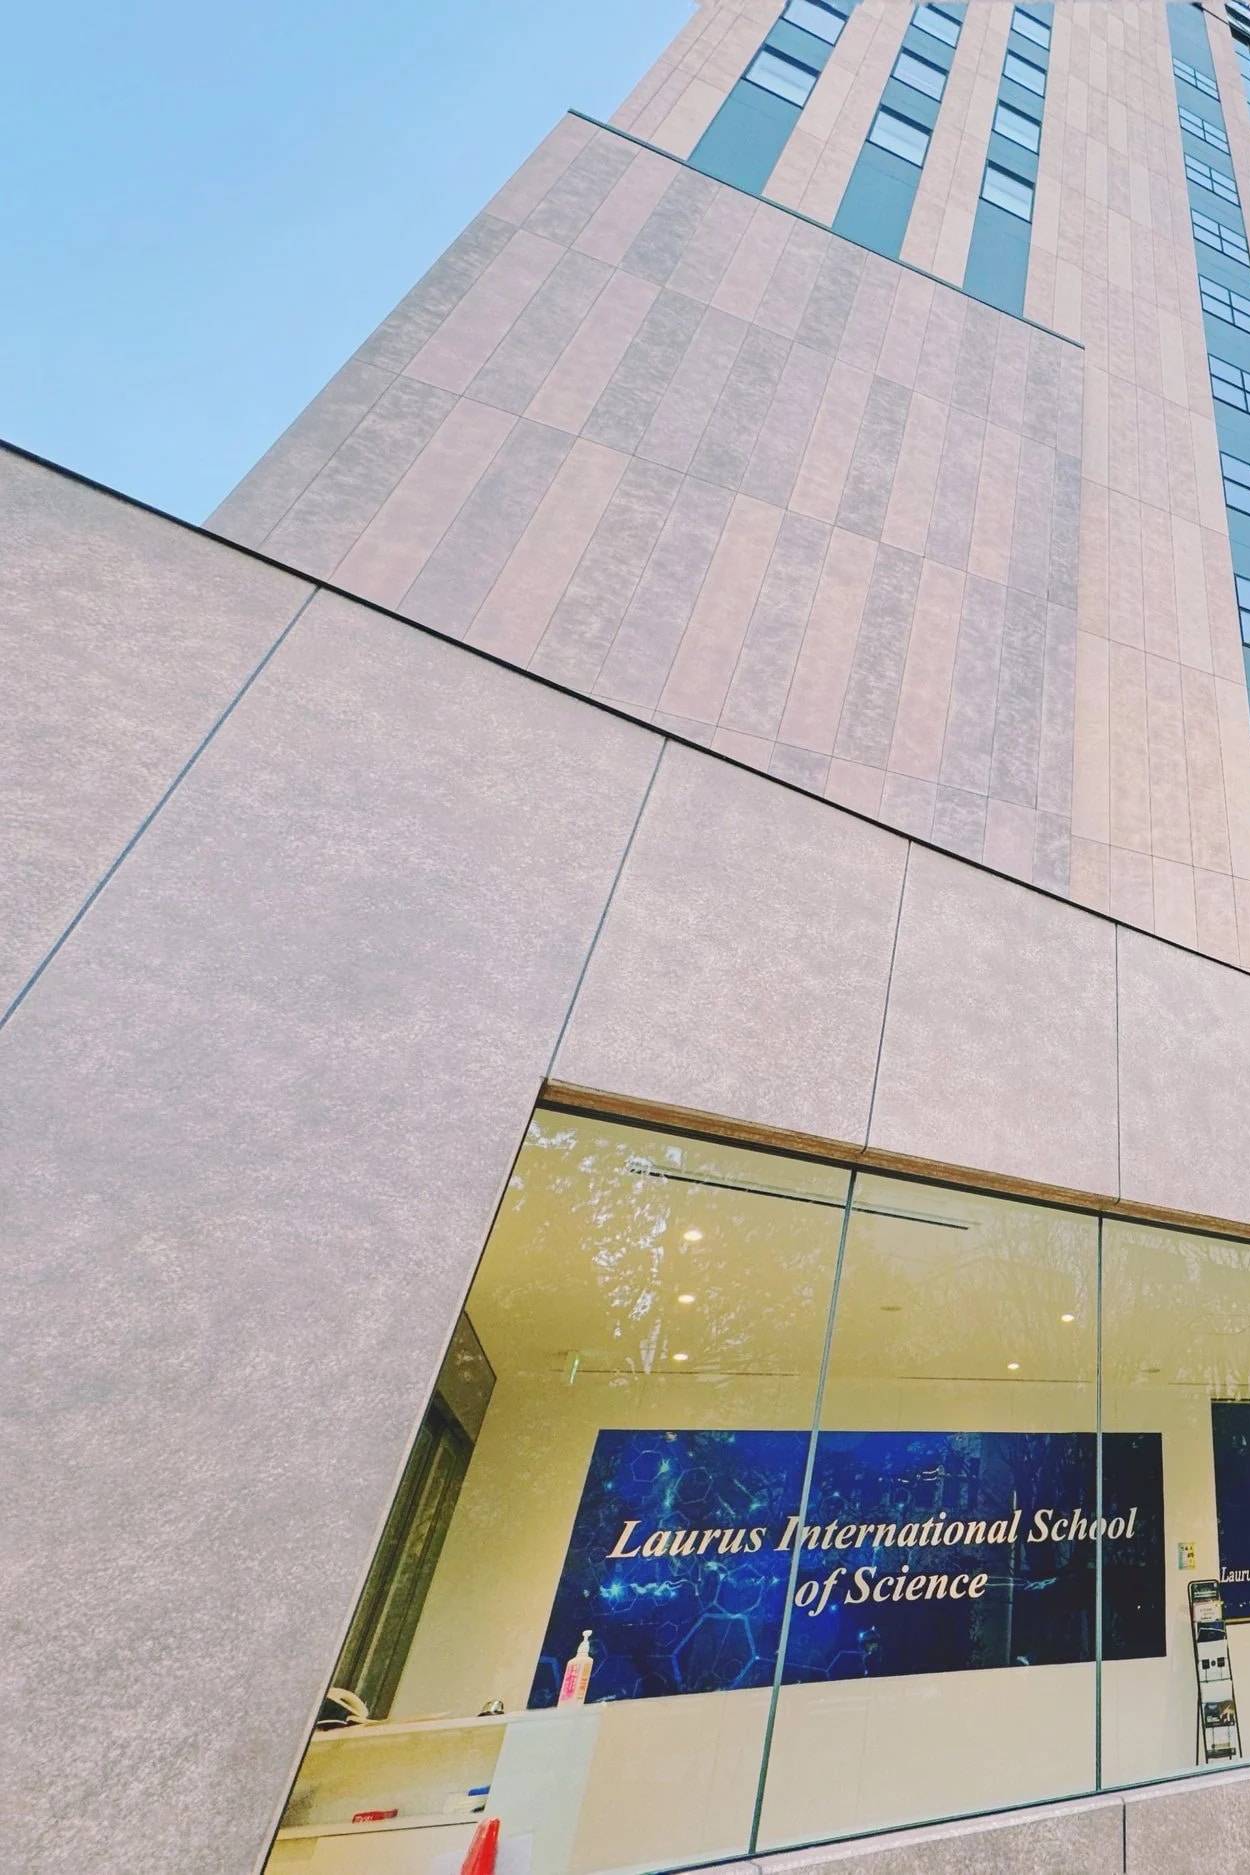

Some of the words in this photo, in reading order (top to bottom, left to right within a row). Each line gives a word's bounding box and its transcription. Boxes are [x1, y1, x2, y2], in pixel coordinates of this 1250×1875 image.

[606, 1520, 767, 1558] Laurus
[773, 1509, 1022, 1552] International
[1027, 1507, 1138, 1543] School
[794, 1567, 847, 1617] of
[844, 1564, 989, 1605] Science
